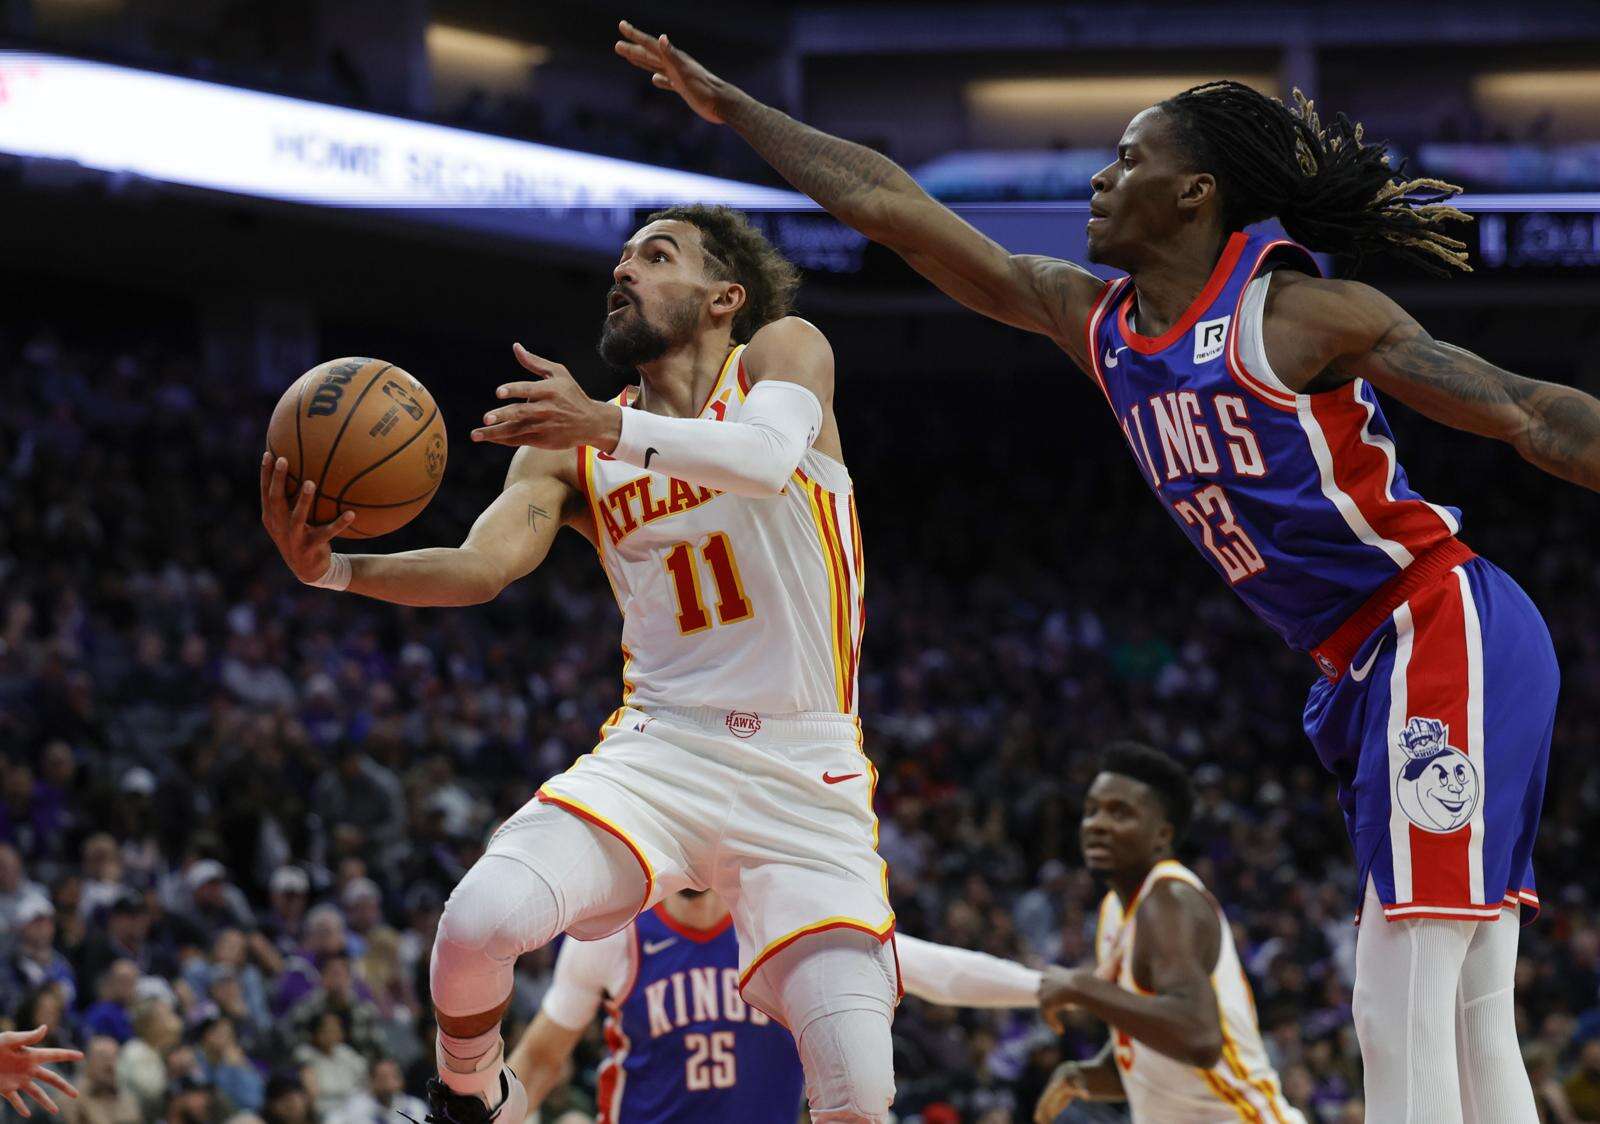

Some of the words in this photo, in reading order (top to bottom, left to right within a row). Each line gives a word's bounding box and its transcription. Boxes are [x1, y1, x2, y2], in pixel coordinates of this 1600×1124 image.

[1204, 324, 1224, 348] R
[597, 472, 727, 548] ATLA
[1172, 484, 1268, 585] 23
[664, 530, 755, 636] 11
[725, 715, 762, 731] HAWKS
[644, 966, 769, 1039] KING
[684, 1031, 738, 1092] 25
